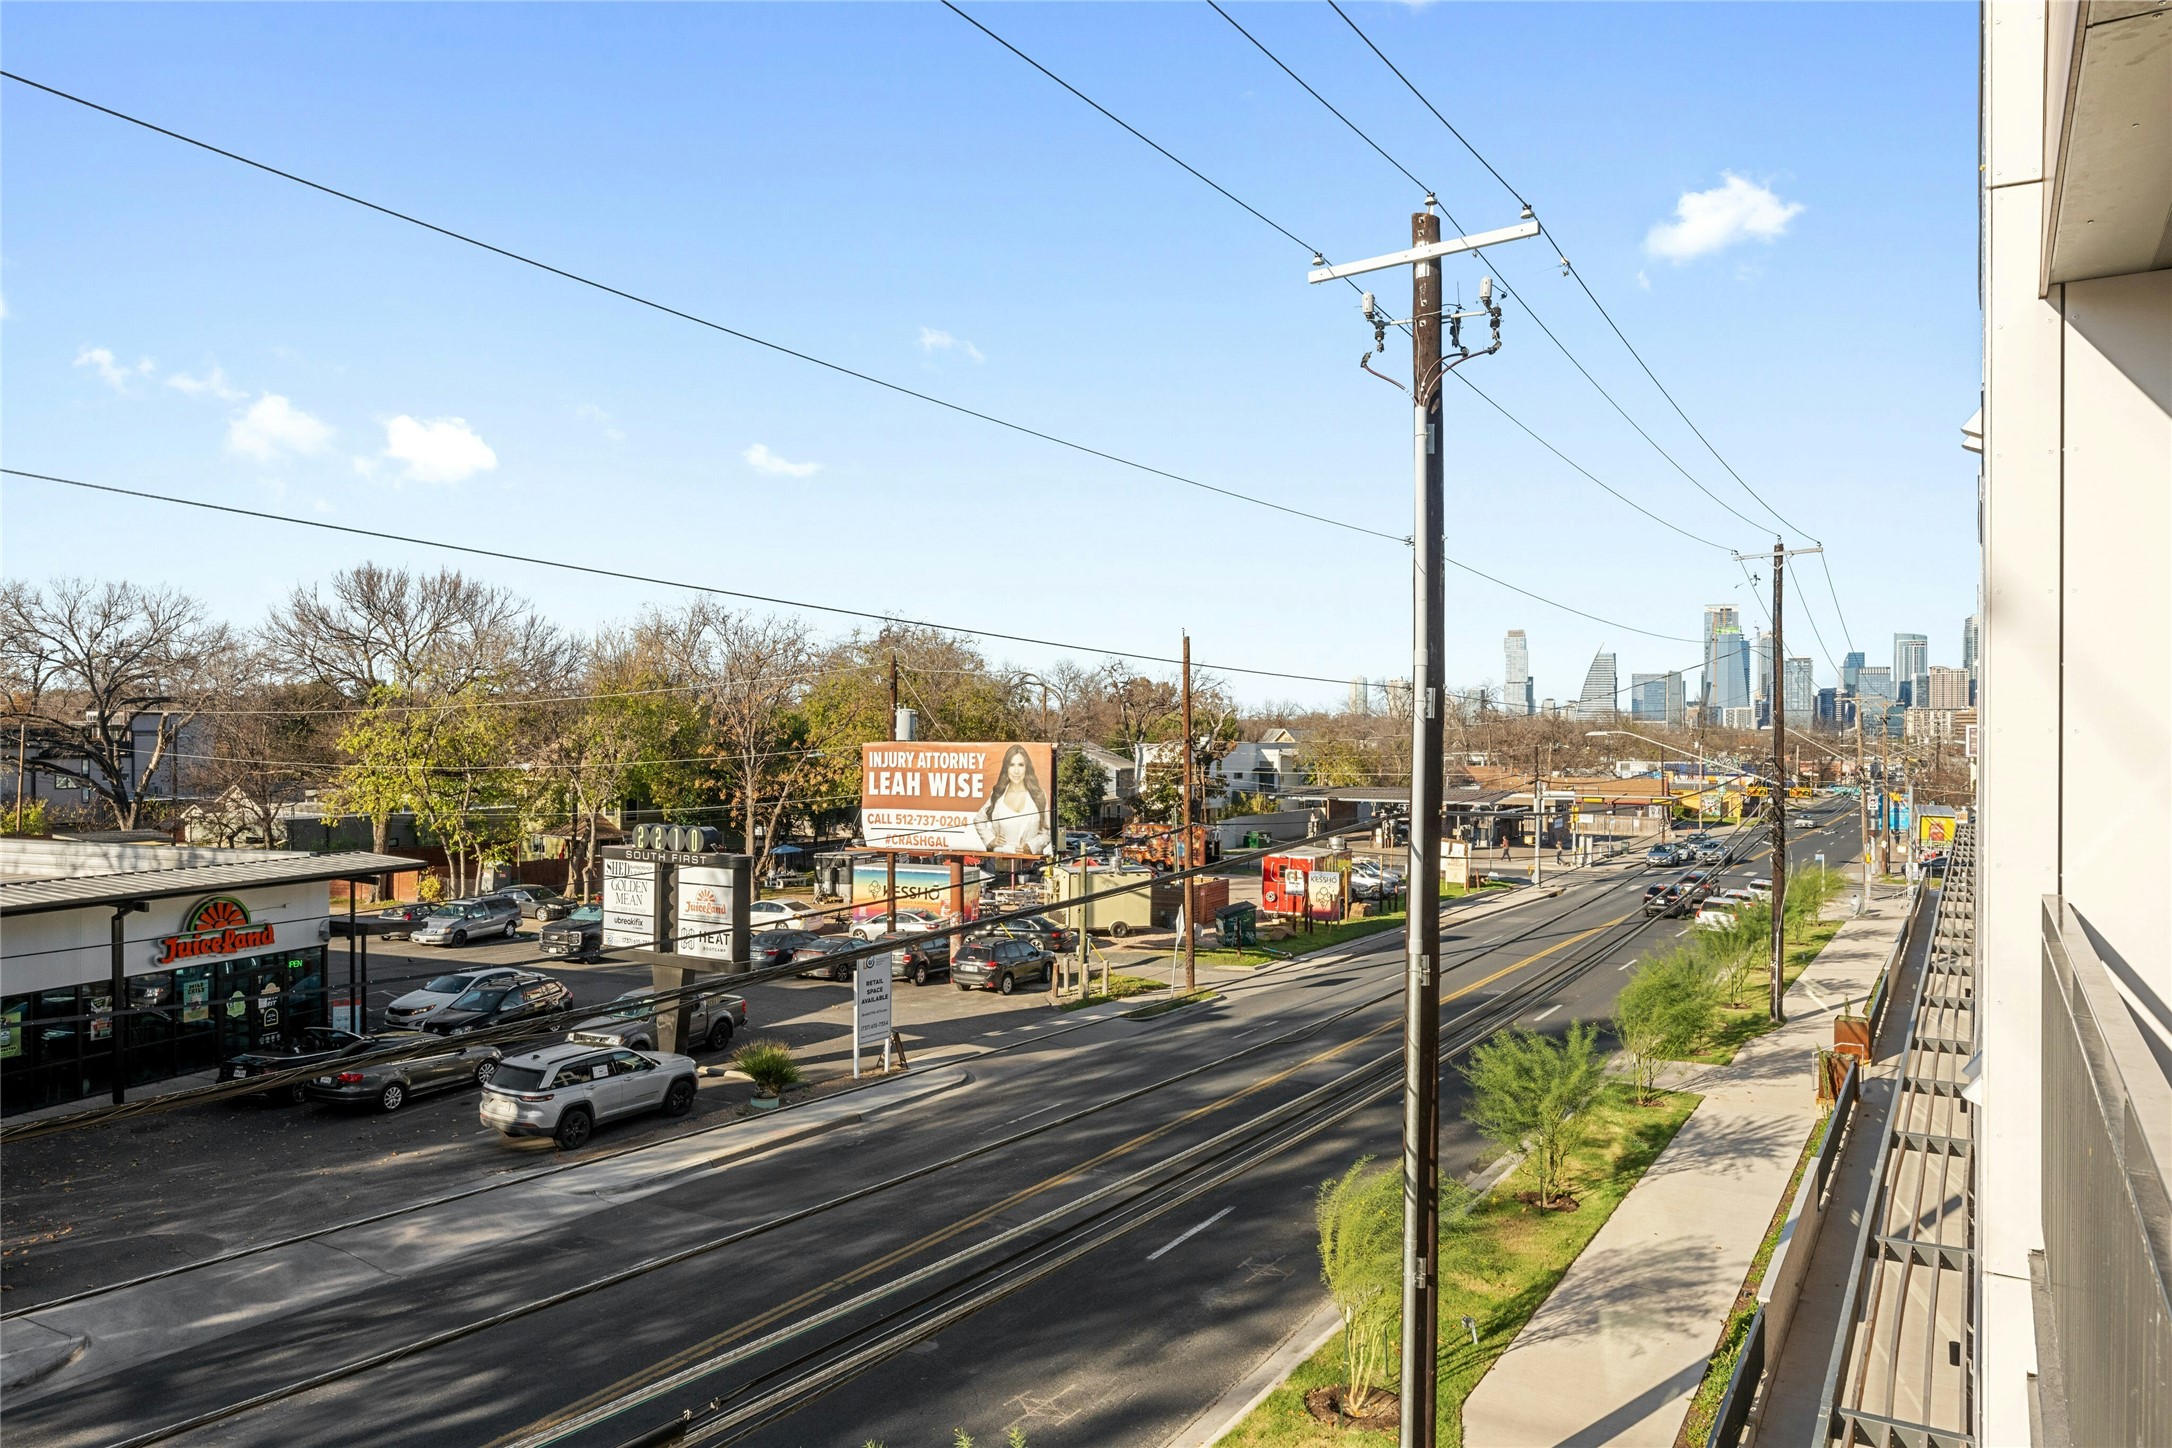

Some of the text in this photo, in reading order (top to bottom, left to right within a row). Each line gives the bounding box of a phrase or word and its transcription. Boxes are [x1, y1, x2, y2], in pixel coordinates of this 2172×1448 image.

[869, 751, 986, 770] INJURY ATTORNEY
[868, 772, 984, 798] LEAH WISE
[867, 813, 968, 828] CALL 512-737-0204
[638, 826, 698, 852] 2210
[885, 834, 949, 848] #CRASHGAL
[625, 850, 707, 864] SOUTH FIRST
[606, 861, 630, 876] SHED
[611, 878, 648, 894] GOLDEN
[616, 892, 643, 906] MEAN
[685, 901, 727, 916] JuiceLand
[160, 923, 275, 964] JuiceLand
[699, 930, 731, 946] HEAT
[861, 994, 888, 1004] AVAILABLE
